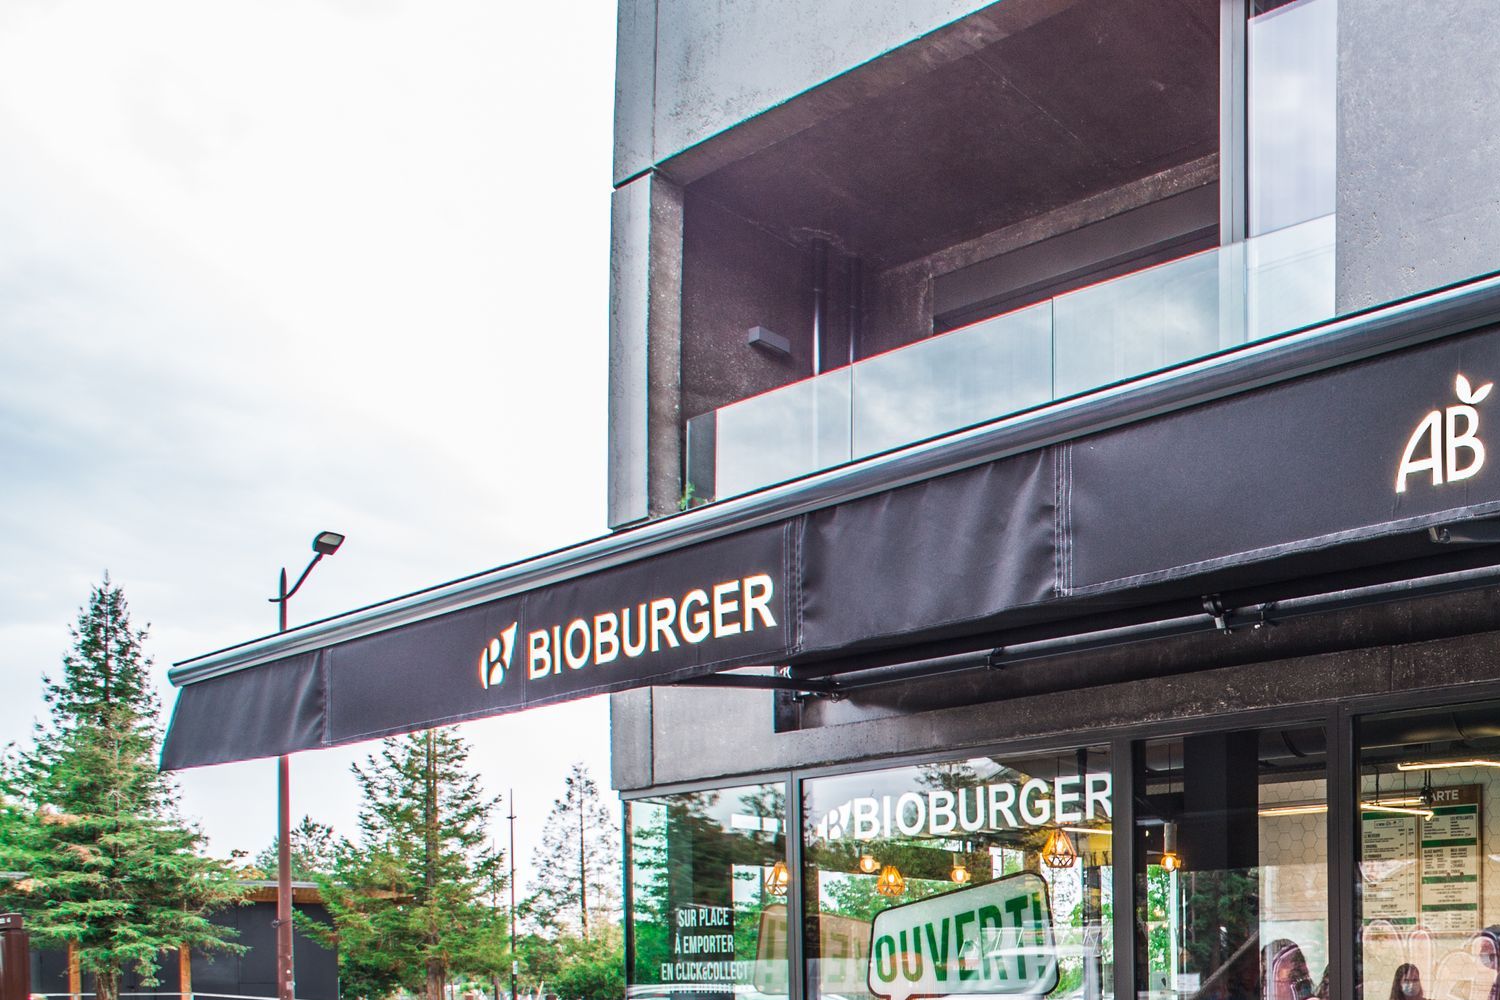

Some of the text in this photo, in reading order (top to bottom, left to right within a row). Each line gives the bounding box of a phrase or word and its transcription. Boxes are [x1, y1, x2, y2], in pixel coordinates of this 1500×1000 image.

[1395, 405, 1485, 493] AB
[529, 573, 777, 680] BIOBURGER
[853, 772, 1113, 840] BIOBURGER
[678, 907, 729, 927] SUR PLACE
[674, 932, 734, 954] À EMPORTER
[661, 962, 674, 981] EN
